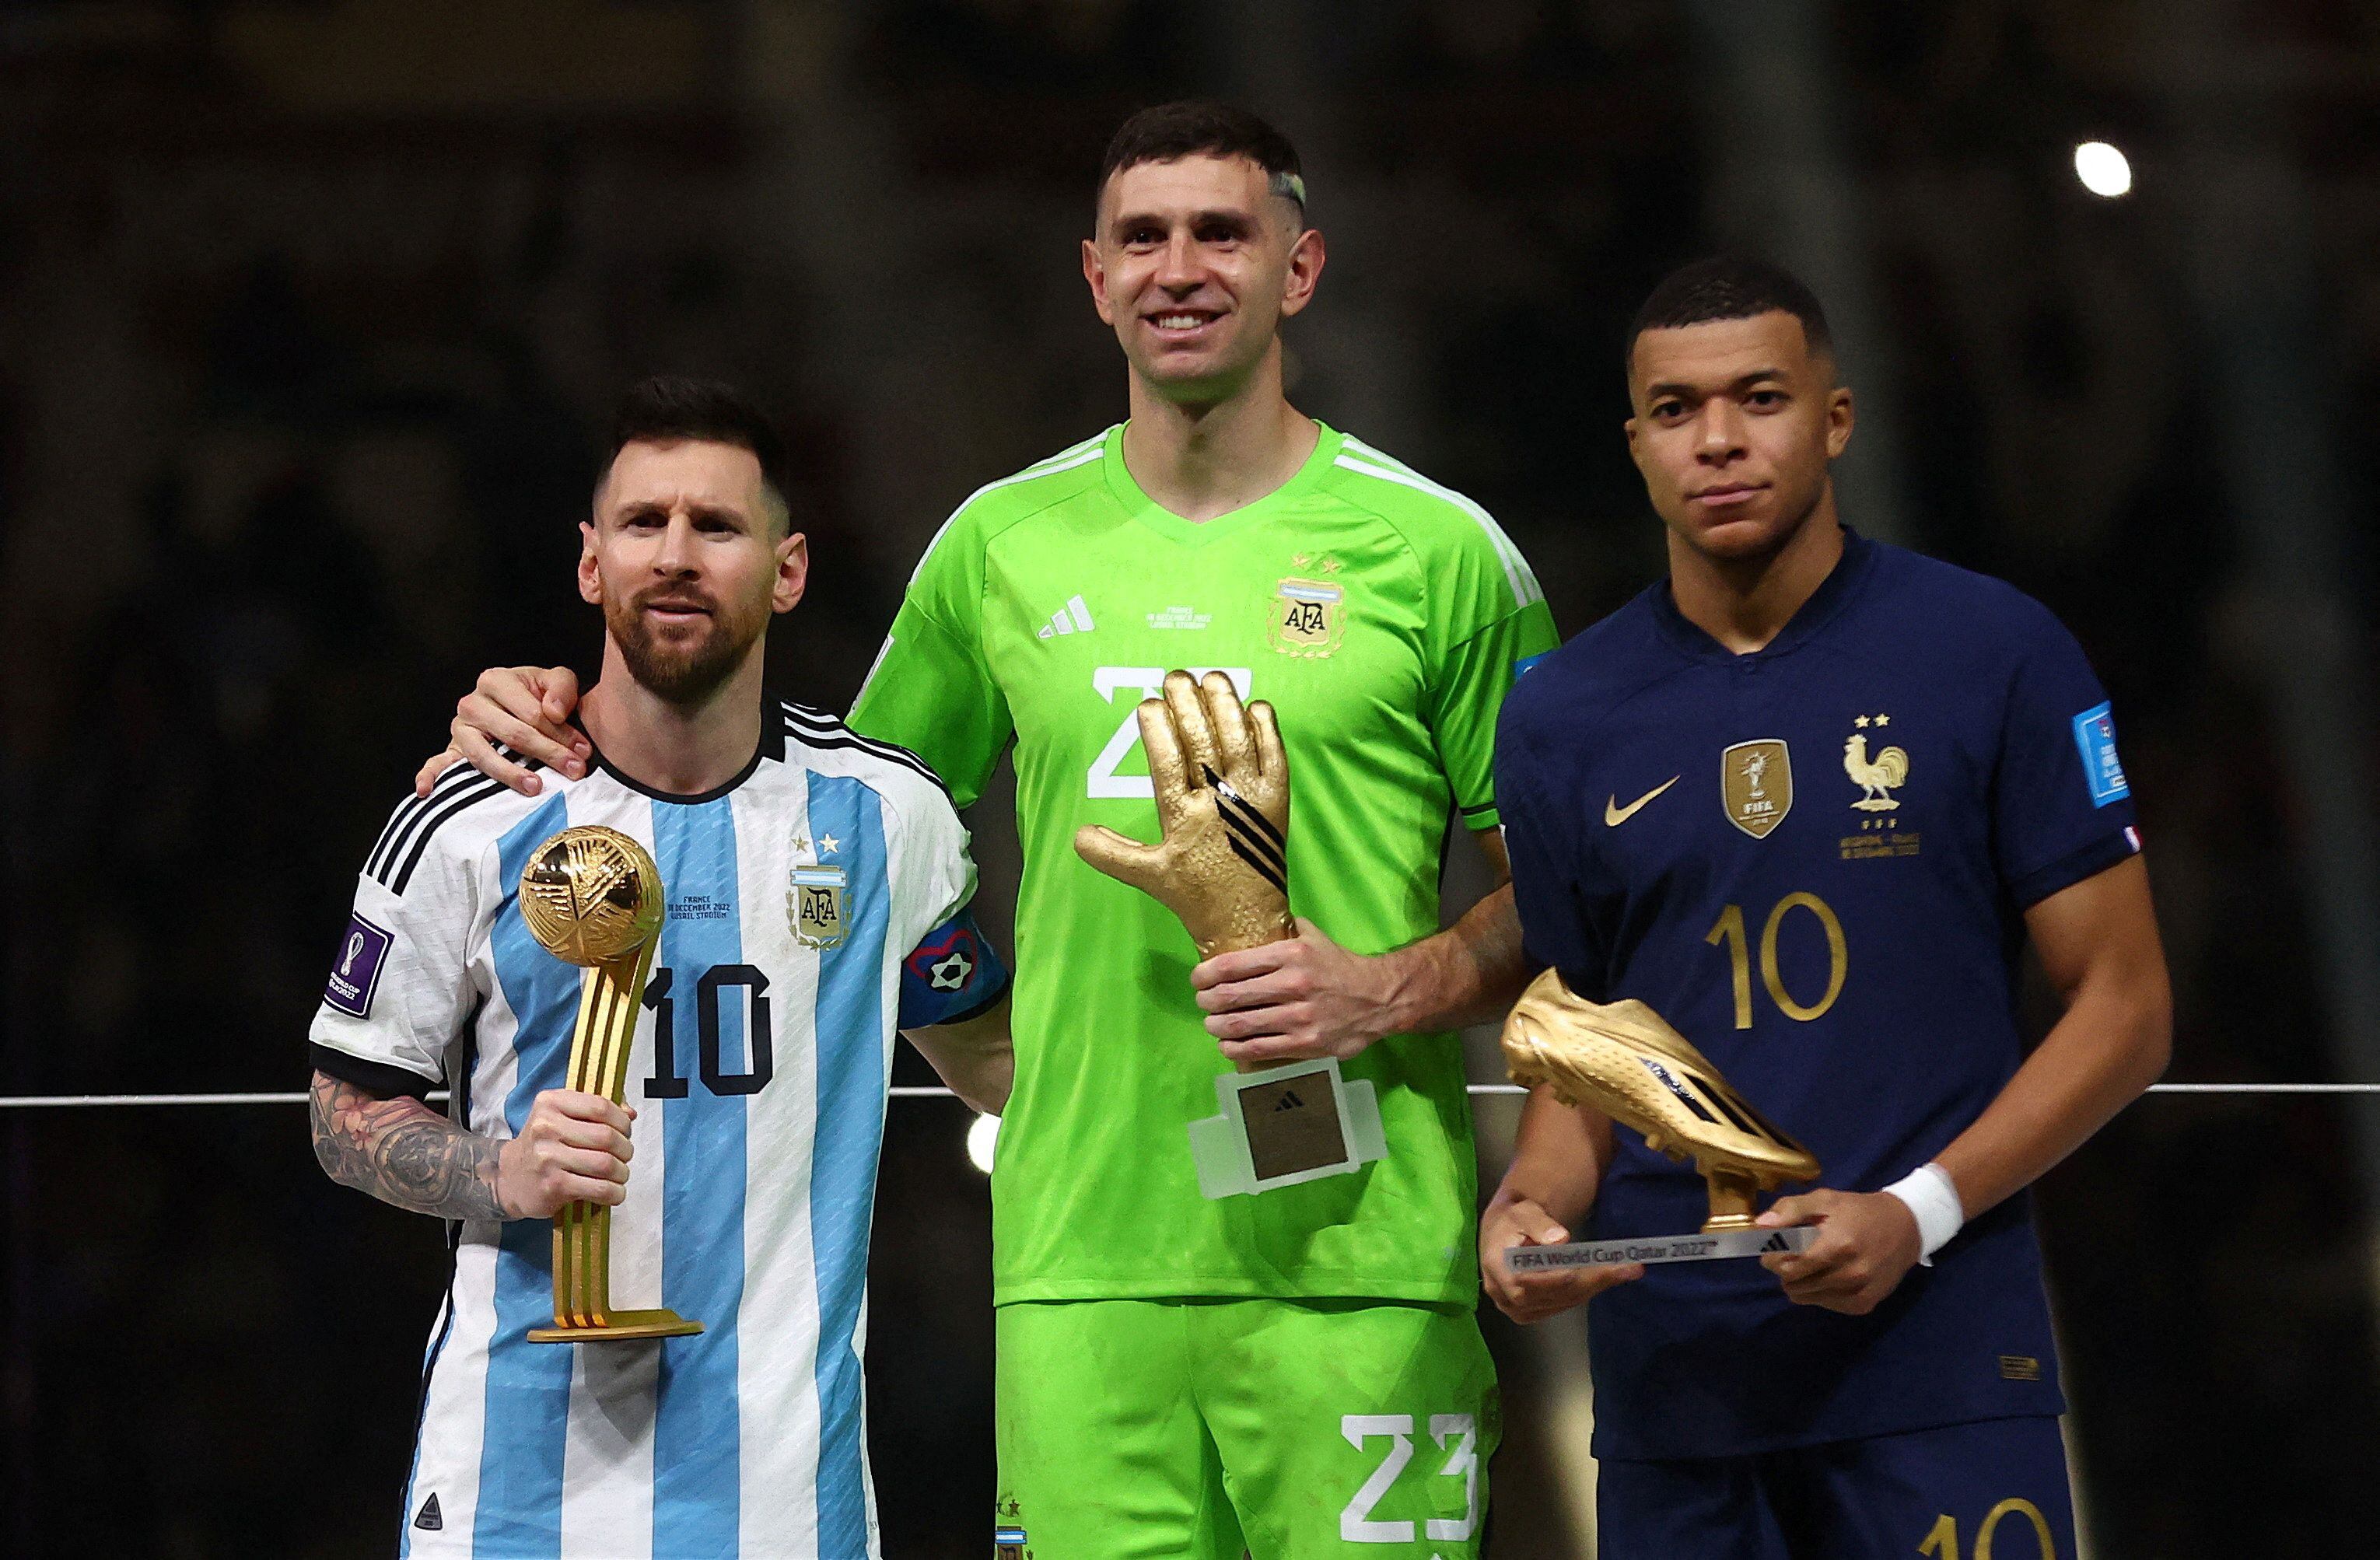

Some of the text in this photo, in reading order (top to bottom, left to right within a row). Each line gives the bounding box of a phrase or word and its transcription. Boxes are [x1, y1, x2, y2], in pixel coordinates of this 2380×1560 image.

[1284, 599, 1325, 635] AFA
[683, 895, 711, 904] FRANCE
[695, 911, 727, 920] STADIUM
[712, 903, 730, 911] 2022
[801, 887, 838, 928] AFA
[1705, 891, 1849, 1030] 10
[642, 964, 773, 1098] 10
[1513, 1254, 1544, 1268] FIFA
[1545, 1249, 1591, 1265] World
[1592, 1247, 1626, 1264] Cup
[1626, 1246, 1671, 1261] Qatar
[1340, 1414, 1477, 1542] 23
